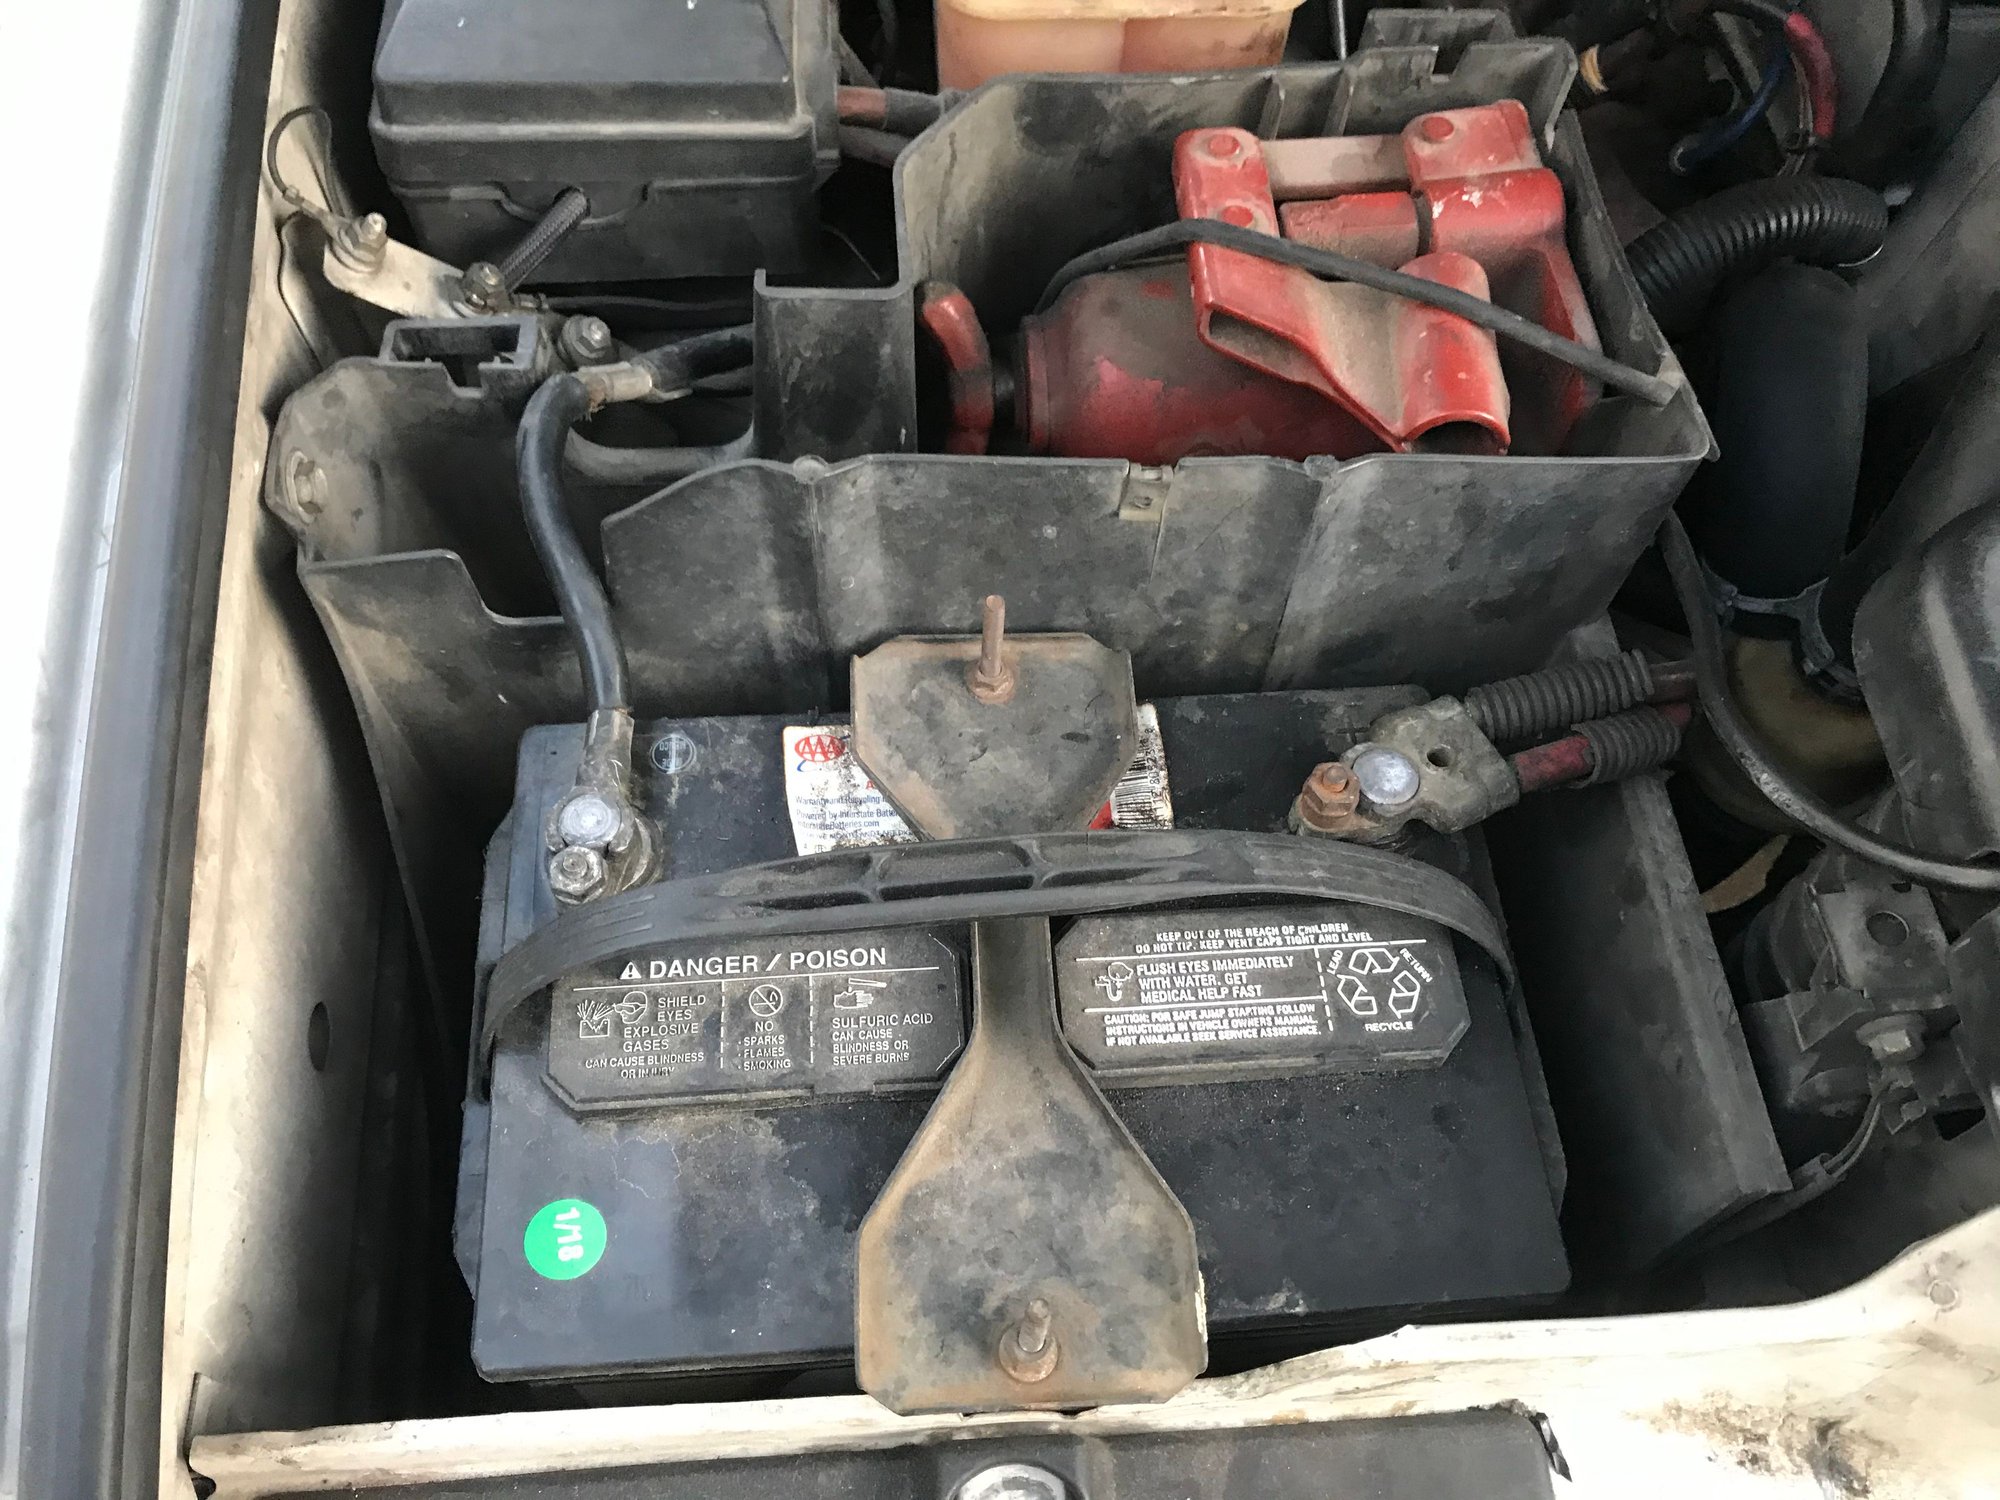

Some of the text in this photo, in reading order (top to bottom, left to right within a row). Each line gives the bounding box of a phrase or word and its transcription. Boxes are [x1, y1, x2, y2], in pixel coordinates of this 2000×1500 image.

[795, 735, 846, 762] AAA
[829, 811, 837, 820] by
[1156, 923, 1349, 942] KEEP OUT OF THE REACH OF CHILDREN
[1135, 944, 1150, 954] DO
[1153, 942, 1173, 953] NOT
[1199, 939, 1224, 950] KEEP
[1227, 938, 1253, 949] VENT
[1256, 936, 1283, 947] CAPS
[1284, 935, 1315, 945] TIGHT
[1318, 933, 1339, 943] AND
[1342, 932, 1373, 942] LEVEL
[650, 947, 886, 979] DANGER / POISON
[1136, 955, 1294, 976] FLUSH EYES IMMEDIATELY
[1327, 949, 1343, 975] LEAD
[1400, 948, 1433, 982] RETURN
[1139, 972, 1247, 990] WITH WATER. GET
[658, 995, 706, 1008] SHIELD
[1140, 984, 1262, 1004] MEDICAL HELP FAST
[657, 1009, 692, 1022] EYES
[832, 1013, 934, 1029] SULFURIC ACID
[1104, 1003, 1315, 1025] CAUTION: FOR SAFE JUMP STARTING FOLLOW
[624, 1023, 699, 1038] EXPLOSIVE
[755, 1021, 774, 1033] NO
[1105, 1014, 1318, 1036] INSTRUCTIONS IN VEHICLE OWNERS MANUAL.
[1364, 1021, 1413, 1032] RECYCLE
[743, 1035, 785, 1047] SPARKS
[832, 1028, 893, 1042] CAN CAUSE
[1105, 1025, 1321, 1047] IF NOT AVAILABLE SEEK SERVICE ASSISTANCE.
[623, 1039, 669, 1052] GASES
[743, 1047, 785, 1058] FLAMES
[833, 1040, 909, 1054] BLINDNESS OR
[585, 1052, 704, 1069] CAN CAUSE BLINDNESS
[743, 1059, 791, 1071] SMOKING
[833, 1052, 910, 1066] SEVERE BURNS
[621, 1069, 636, 1079] OR
[553, 1207, 584, 1262] 1/18
